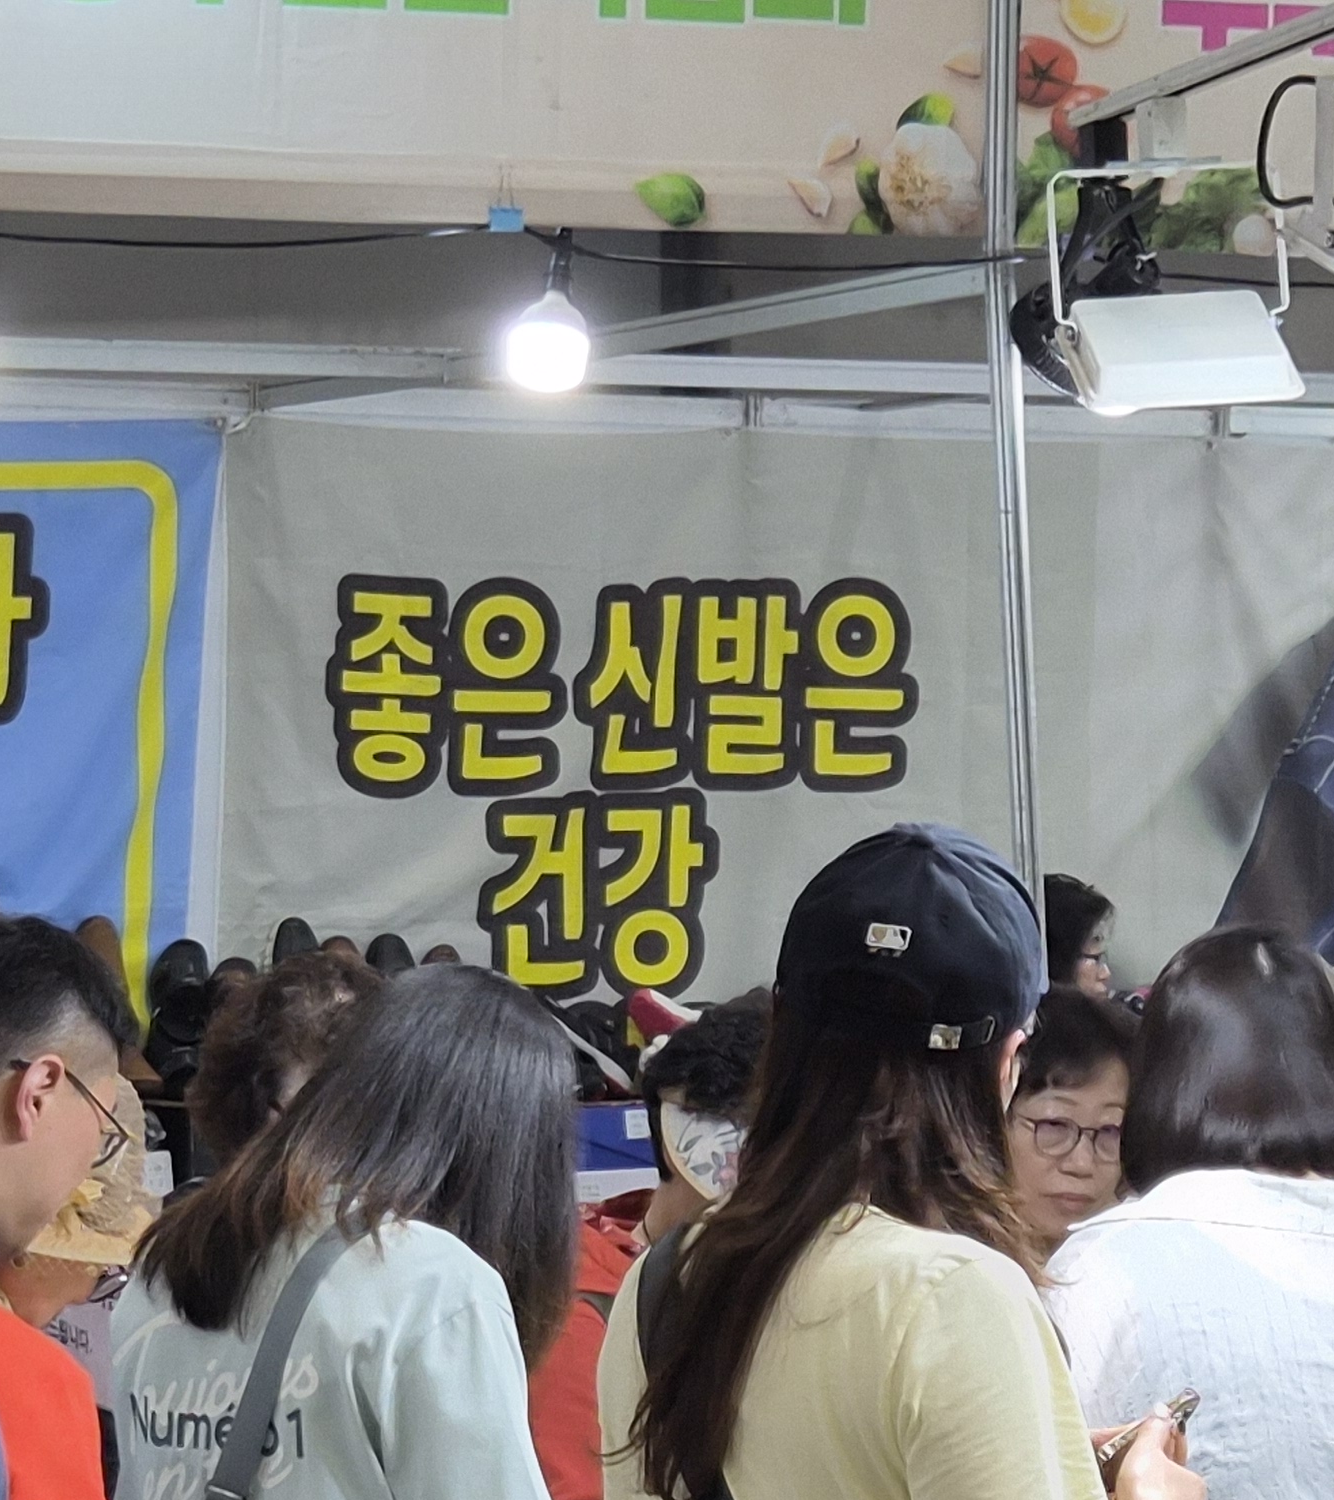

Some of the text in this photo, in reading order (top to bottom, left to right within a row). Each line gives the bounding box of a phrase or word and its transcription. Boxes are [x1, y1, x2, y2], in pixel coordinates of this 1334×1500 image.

[335, 584, 909, 788] 좋은 신발은
[486, 798, 709, 993] 건강
[130, 1393, 304, 1458] Numéo 1
